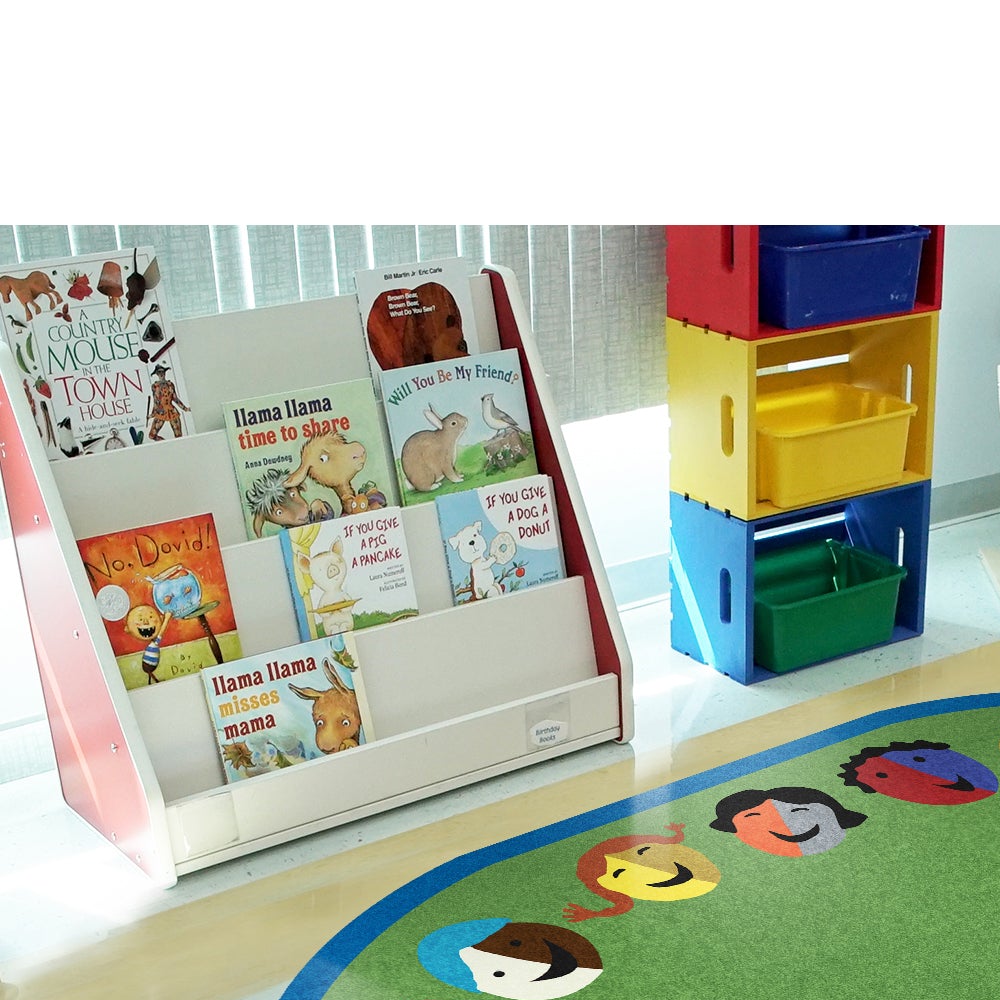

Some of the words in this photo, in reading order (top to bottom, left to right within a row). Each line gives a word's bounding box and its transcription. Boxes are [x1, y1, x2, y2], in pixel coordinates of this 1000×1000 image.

[394, 271, 410, 279] Martin
[80, 309, 88, 320] A
[48, 316, 122, 342] COUNTRY
[48, 332, 139, 374] MOUSE
[82, 366, 92, 376] IN
[94, 363, 112, 374] THE
[54, 369, 143, 406] TOWN
[388, 382, 413, 406] Will
[411, 374, 435, 390] You
[436, 369, 452, 384] Be
[455, 365, 472, 382] My
[475, 364, 519, 384] Friend?
[79, 398, 133, 422] HOUSE
[233, 406, 283, 428] llama
[284, 397, 333, 418] llama
[238, 428, 278, 450] time
[280, 425, 298, 442] to
[302, 416, 350, 438] share
[245, 460, 262, 470] Anna
[486, 494, 496, 510] IF
[499, 491, 518, 506] YOU
[521, 486, 547, 500] GIVE
[508, 510, 514, 524] A
[516, 506, 539, 520] DOG
[542, 502, 548, 516] A
[343, 524, 354, 538] IF
[356, 520, 374, 536] YOU
[376, 516, 400, 532] GIVE
[518, 520, 550, 540] DONUT
[360, 538, 367, 551] A
[368, 534, 387, 549] PIG
[352, 556, 358, 569] A
[360, 547, 402, 568] PANCAKE
[171, 662, 202, 676] David
[212, 675, 264, 696] llama
[266, 657, 317, 682] llama
[218, 690, 280, 718] misses
[224, 714, 276, 740] mama
[536, 726, 560, 736] Birthday
